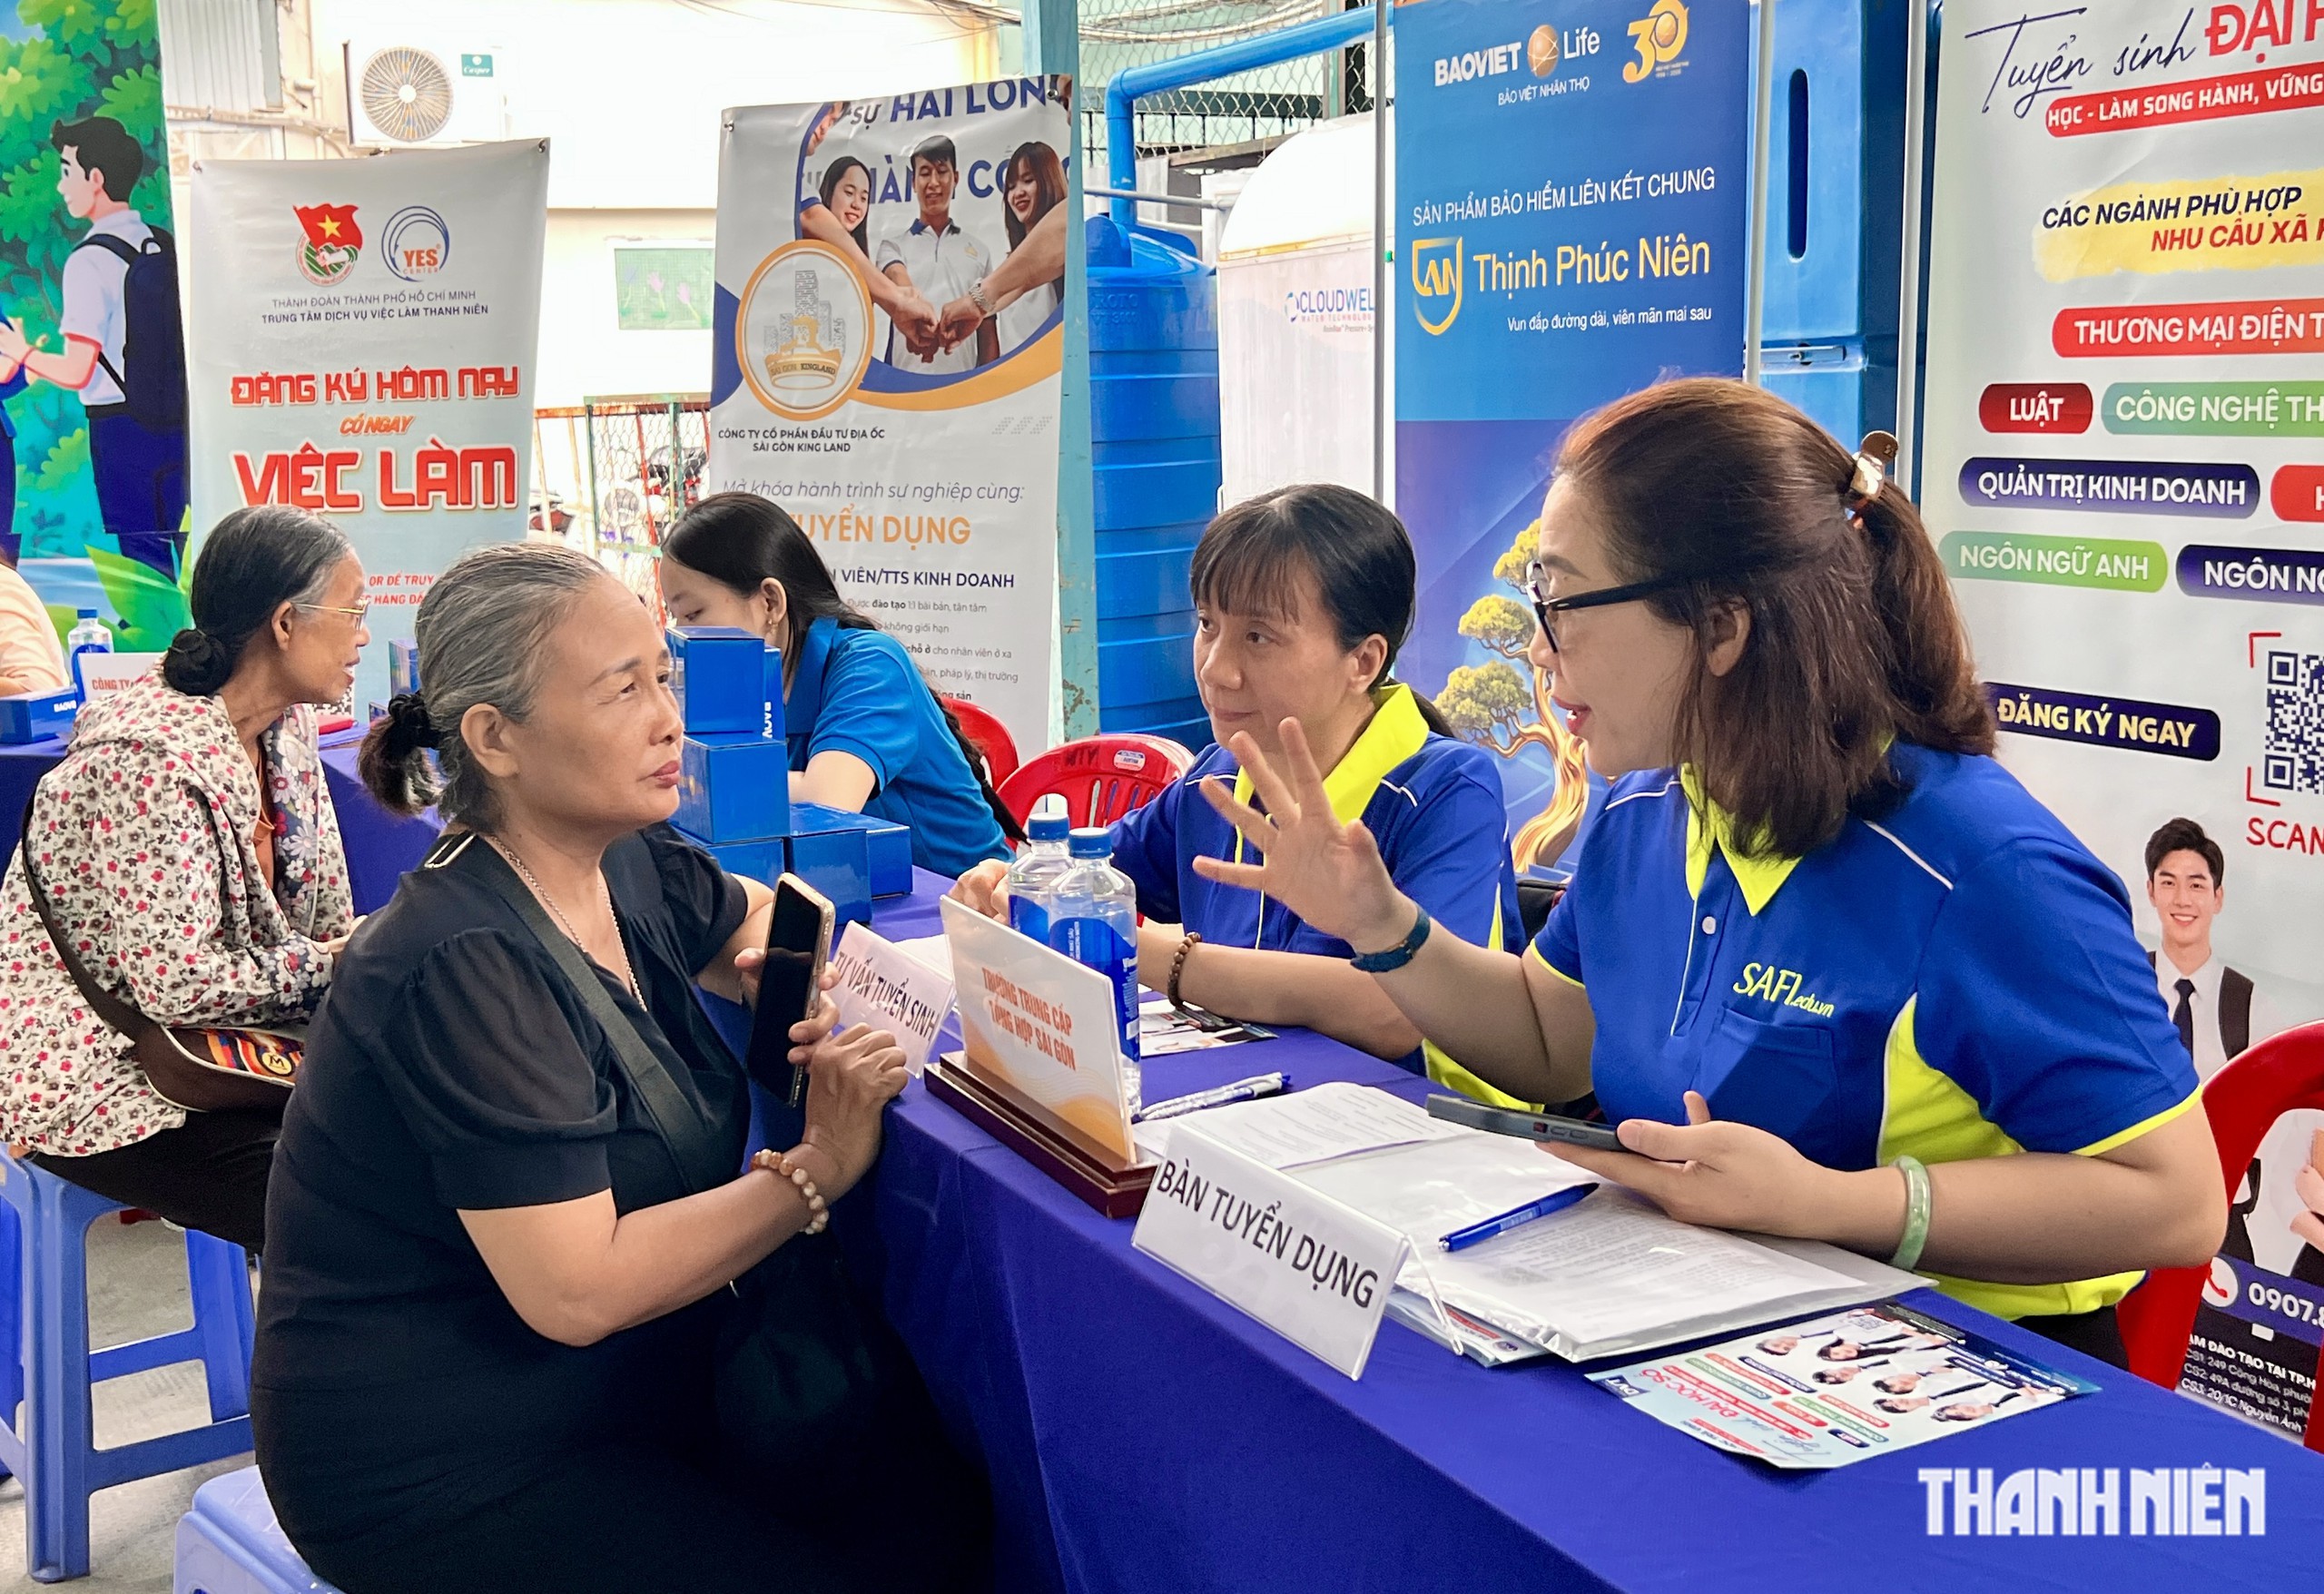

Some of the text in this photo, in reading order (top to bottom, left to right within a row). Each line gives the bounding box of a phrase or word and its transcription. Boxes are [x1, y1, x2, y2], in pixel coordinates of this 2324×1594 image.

[1434, 26, 1600, 86] BAOVIET Life
[1622, 0, 1689, 83] 30
[1965, 6, 2094, 119] Tuyển
[2113, 7, 2196, 76] sinh
[2204, 0, 2291, 64] ĐẠI
[1498, 75, 1590, 106] BẢO VIỆT NHÂN THỌ
[2048, 73, 2324, 131] HỌC LÀM SONG HÀNH, VỮNG
[1413, 166, 1715, 227] SẢN PHẨM BẢO HIỂM LIÊN KẾT CHUNG
[2043, 186, 2302, 231] CÁC NGÀNH PHÙ HỢP
[2152, 229, 2202, 253] NHU
[2210, 211, 2263, 248] CẦU
[2269, 213, 2309, 244] XÃ
[403, 248, 438, 268] YES
[1473, 233, 1710, 300] Thịnh Phúc Niên
[262, 302, 488, 324] TRUNG TÂM DỊCH VỤ VIỆC LÀM THANH NIÊN
[272, 288, 477, 308] THÀNH ĐOÀN THÀNH PHỐ HỒ CHÍ MINH
[1507, 305, 1712, 333] Vun đắp đường dài, viên mãn mai sau
[2073, 306, 2305, 348] THƯƠNG MẠI ĐIỆN
[231, 365, 520, 406] ĐĂNG KÝ HÔM NAY
[340, 413, 416, 434] CÓ NGAY
[2009, 389, 2065, 428] LUẬT
[2115, 388, 2280, 429] CÔNG NGHỆ
[718, 425, 885, 442] CÔNG TY CỔ PHẦN ĐẦU TƯ ĐỊA ỐC
[753, 439, 852, 452] SÀI GÒN KING LAND
[378, 438, 518, 510] LÀM
[723, 479, 1025, 504] Mở khóa hành trình sự nghiệp cùng:
[1977, 464, 2247, 506] QUẢN TRỊ KINH DOANH
[883, 515, 971, 550] DỤNG
[842, 566, 909, 585] VIÊN/TTS
[913, 572, 951, 586] KINH
[956, 574, 1015, 588] DOANH
[1959, 541, 2149, 580] NGÔN NGỮ ANH
[2204, 556, 2290, 592] NGÔN
[405, 575, 434, 585] TRUY
[374, 593, 406, 605] HÀNG
[872, 598, 889, 608] đào
[891, 600, 906, 611] tạo
[918, 600, 931, 611] bài
[969, 602, 988, 613] tâm
[883, 622, 950, 634] không giới hạn
[932, 644, 949, 655] cho
[950, 645, 973, 656] nhân
[975, 647, 993, 658] viên
[92, 677, 118, 690] CÔNG
[940, 668, 962, 680] pháp
[975, 670, 988, 680] thị
[989, 671, 1019, 684] trường
[1997, 694, 2196, 749] ĐĂNG KÝ NGAY
[835, 950, 940, 1042] TƯ VẤN TUYỂN SINH
[1018, 987, 1051, 1026] TRUNG
[1051, 1001, 1072, 1037] CẤP
[1014, 1015, 1077, 1072] HỢP SÀI GÒN
[1157, 1158, 1378, 1309] BÀN TUYỂN DỤNG
[2208, 1341, 2286, 1379] ĐÀO TẠO TẠI
[2208, 1356, 2227, 1370] 249
[2209, 1373, 2230, 1388] 49A
